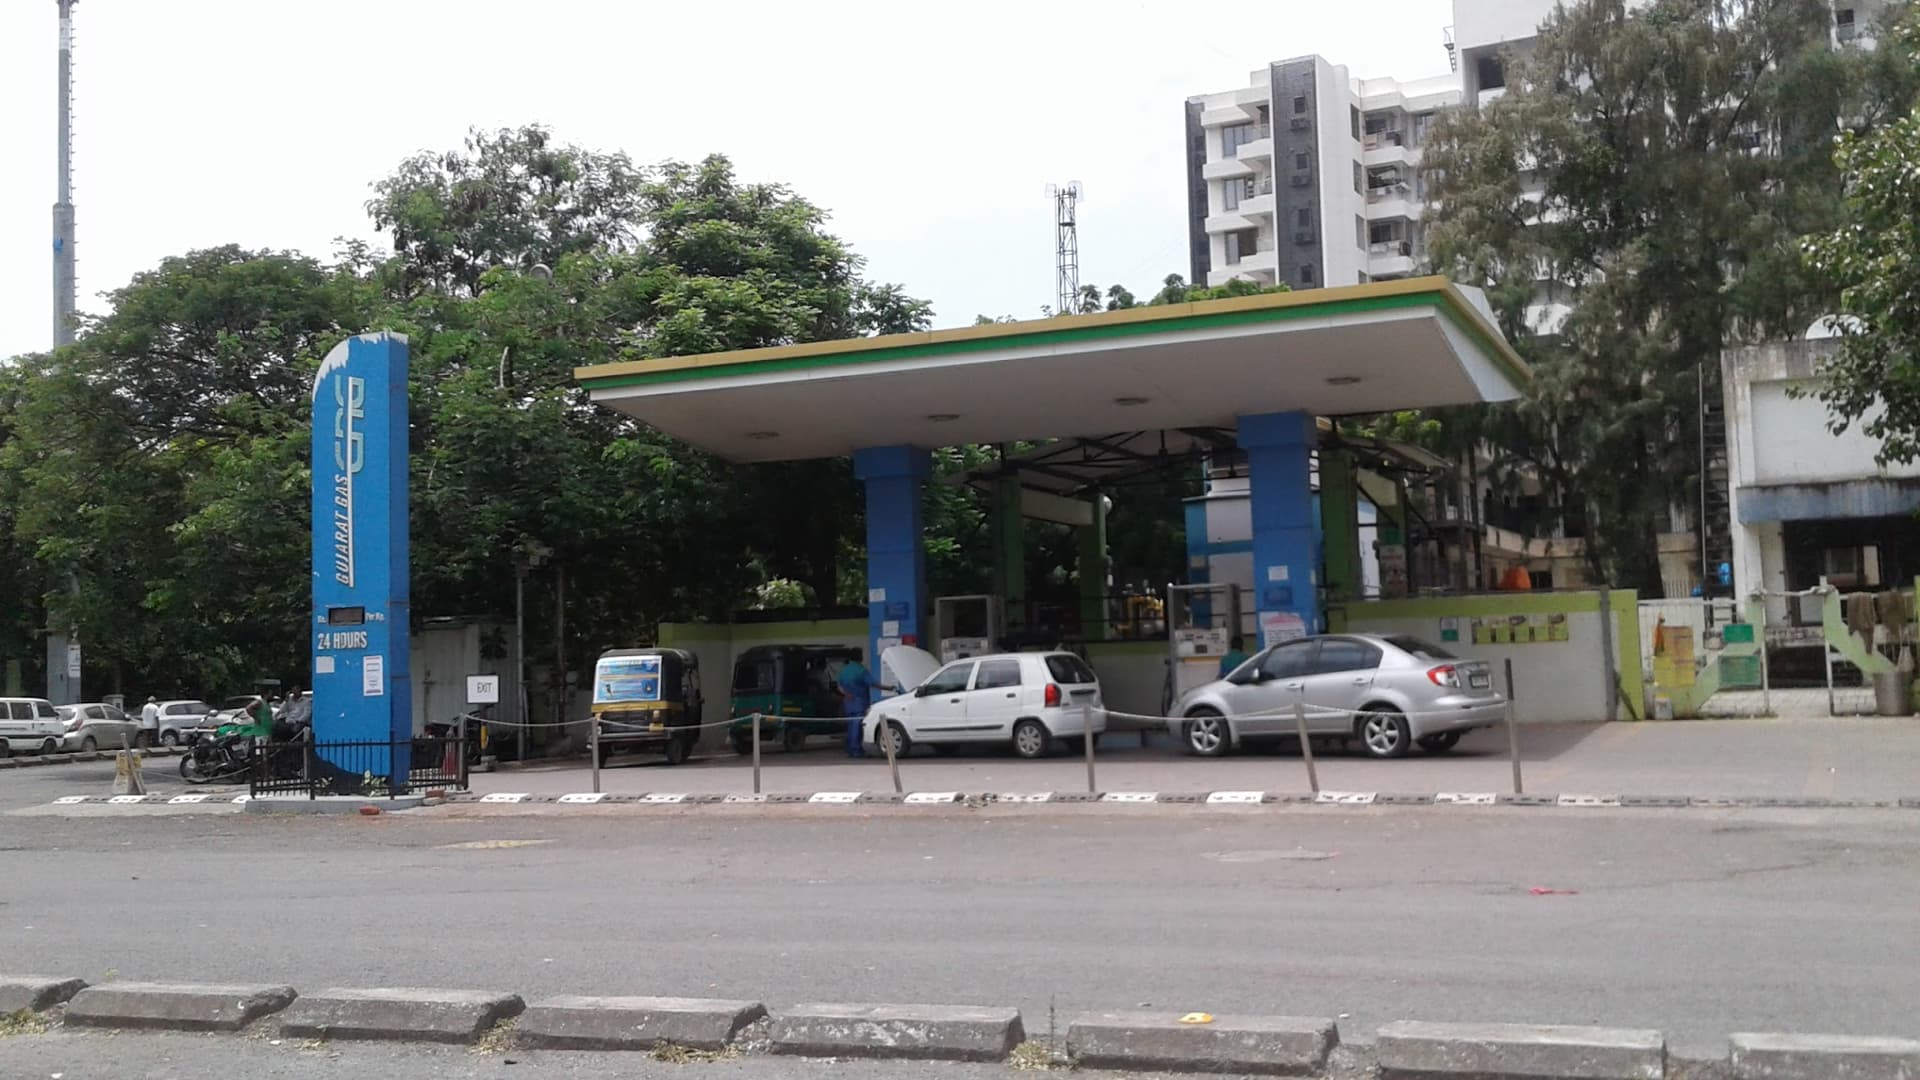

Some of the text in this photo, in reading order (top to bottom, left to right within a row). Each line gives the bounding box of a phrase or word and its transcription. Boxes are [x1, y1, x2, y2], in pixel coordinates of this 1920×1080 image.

[335, 474, 349, 585] GUJARAT GAS
[317, 631, 368, 650] 24 HOURS
[477, 682, 493, 693] EXIT
